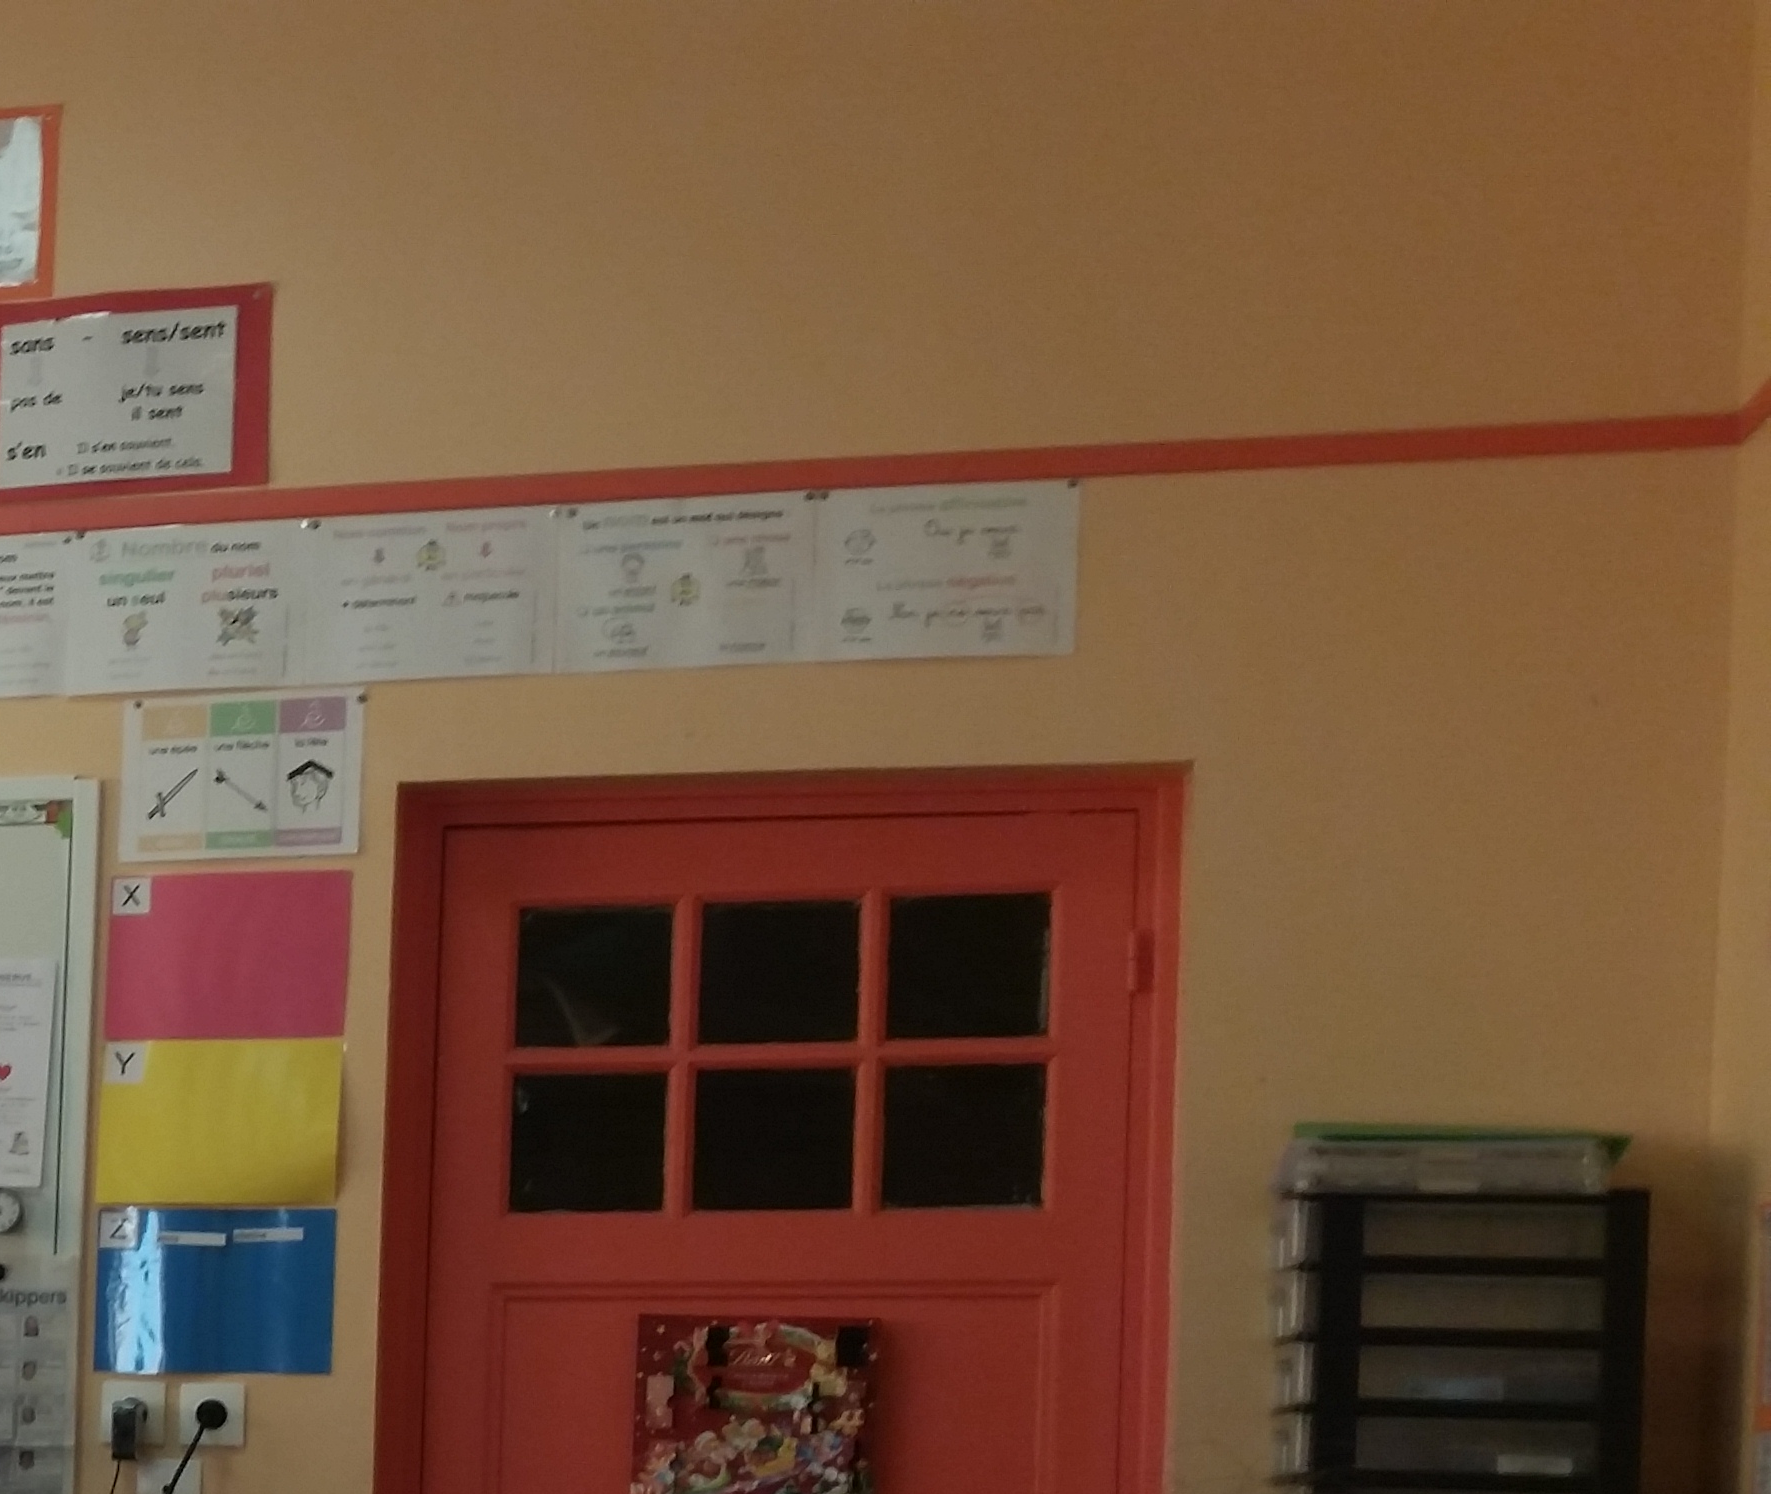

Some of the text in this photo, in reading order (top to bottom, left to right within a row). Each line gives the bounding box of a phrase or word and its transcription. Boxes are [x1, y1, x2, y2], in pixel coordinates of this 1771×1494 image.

[10, 320, 226, 353] sans sens/sent
[6, 442, 46, 461] s'en
[121, 884, 140, 908] X
[115, 1051, 135, 1075] Y
[109, 1217, 129, 1240] Z
